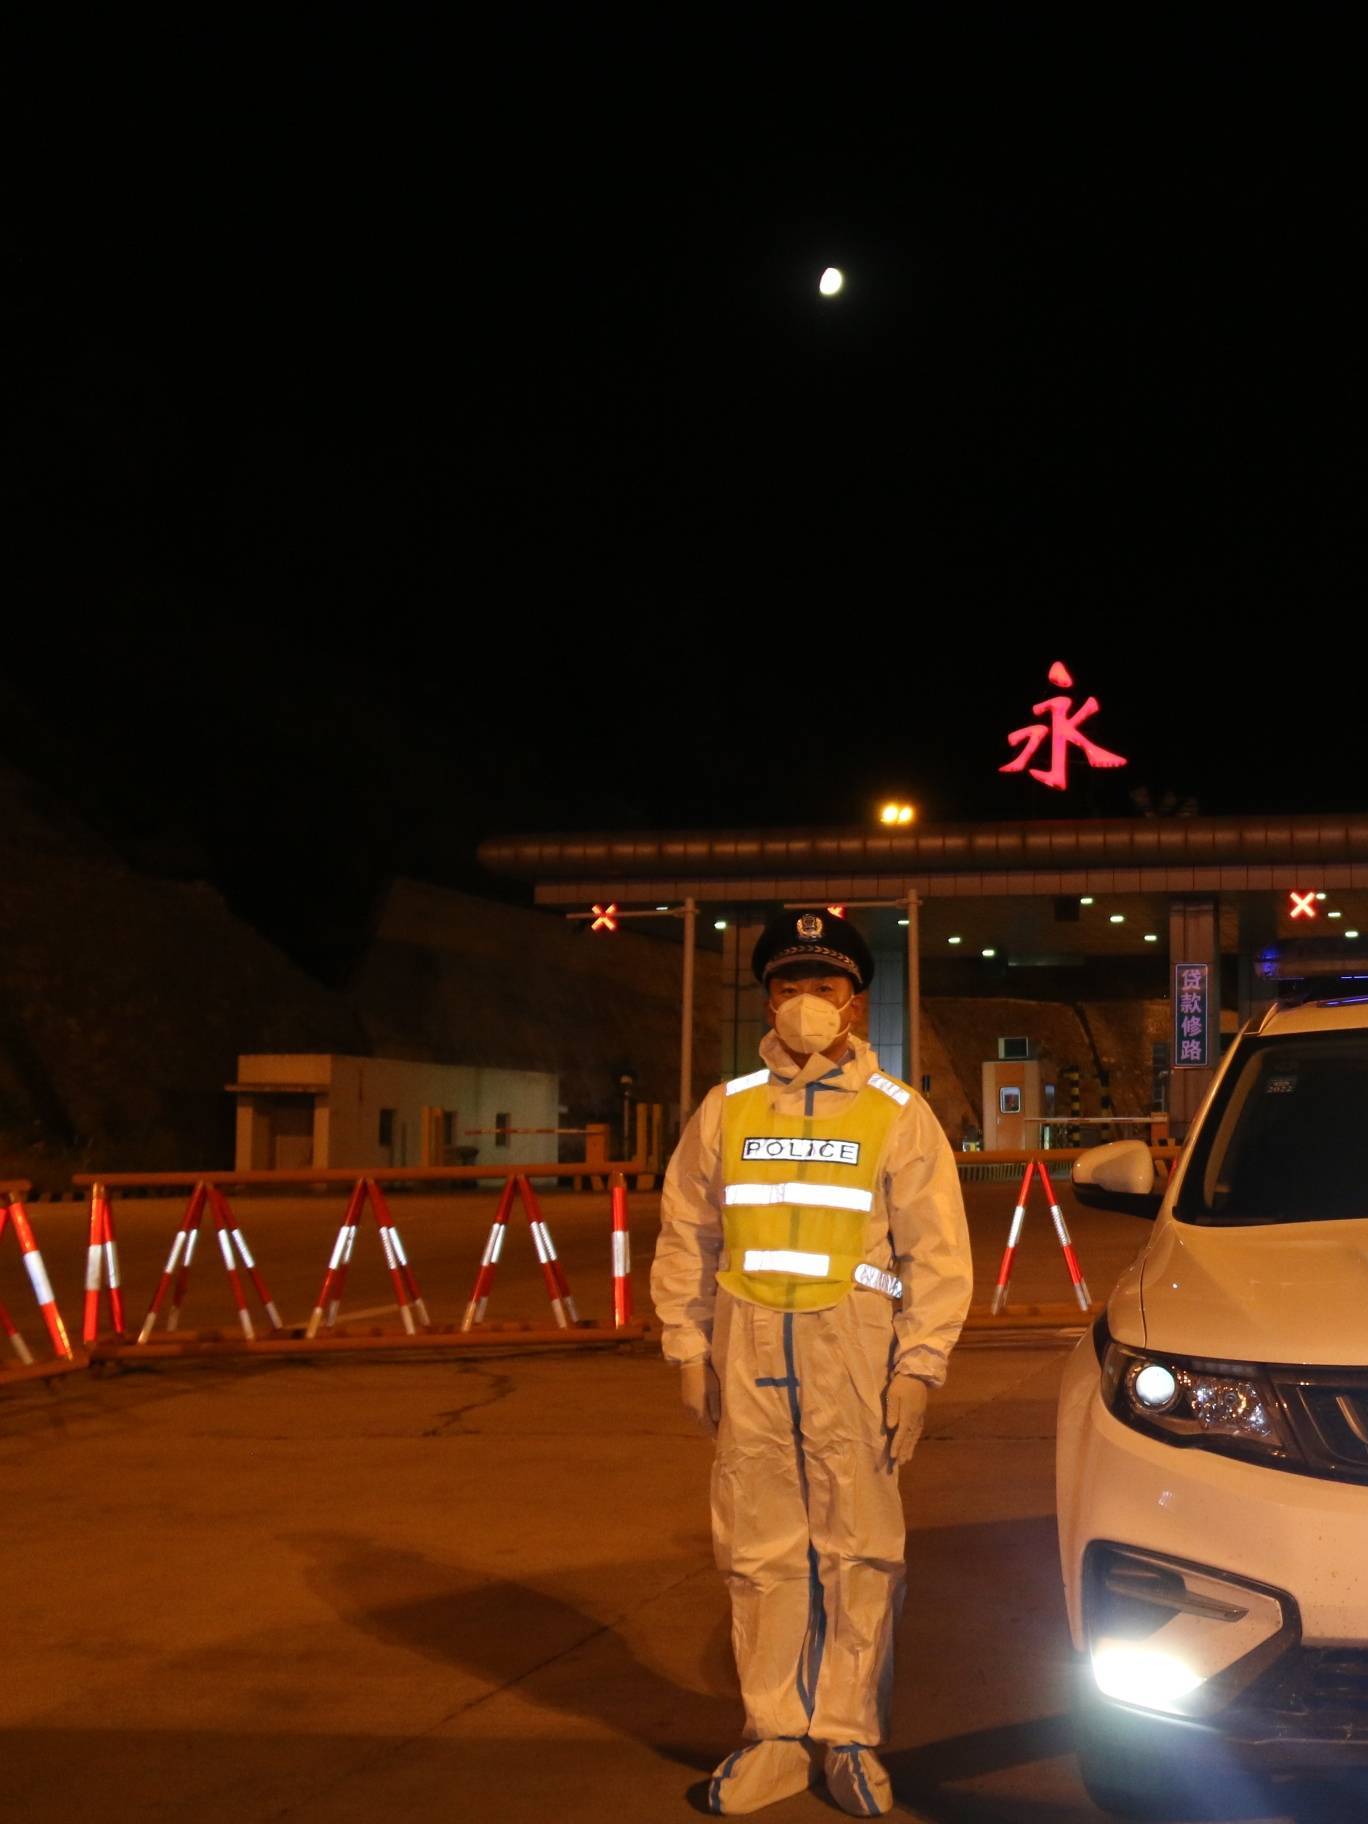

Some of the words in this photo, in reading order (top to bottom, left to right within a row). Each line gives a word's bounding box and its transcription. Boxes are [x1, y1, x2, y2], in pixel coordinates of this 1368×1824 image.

[1000, 660, 1127, 790] 永
[1180, 968, 1202, 1061] 贷款修路
[746, 1141, 856, 1159] POLICE
